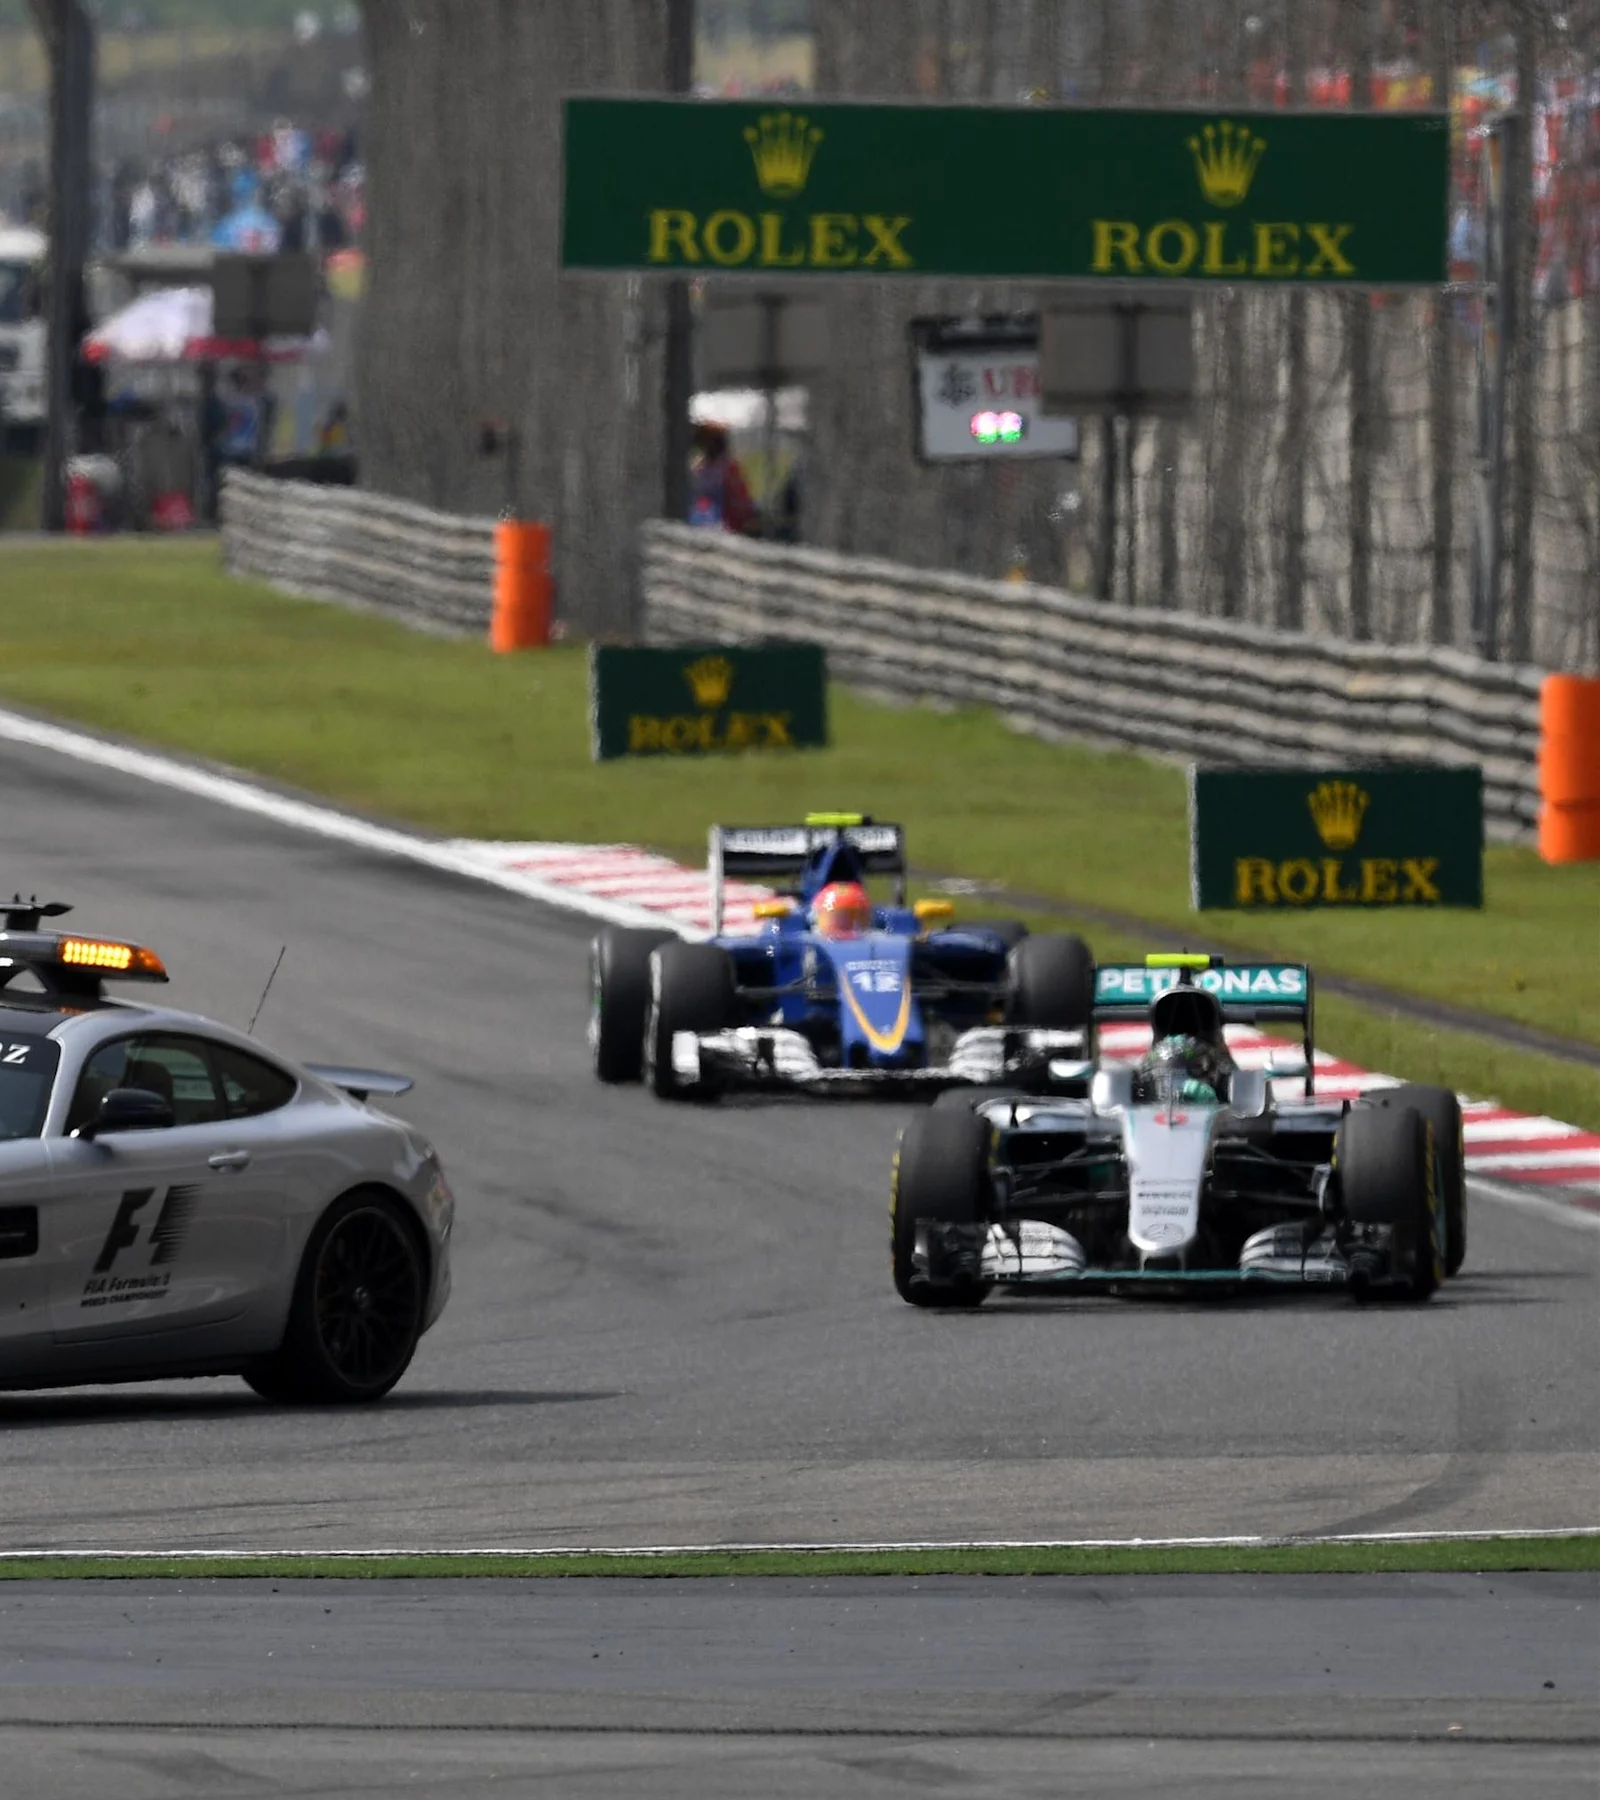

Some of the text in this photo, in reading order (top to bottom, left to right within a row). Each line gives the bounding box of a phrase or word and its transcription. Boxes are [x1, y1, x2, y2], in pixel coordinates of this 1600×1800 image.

[647, 208, 914, 266] ROLEX
[1090, 219, 1356, 276] ROLEX
[628, 711, 794, 752] ROLEX
[1235, 857, 1440, 904] ROLEX
